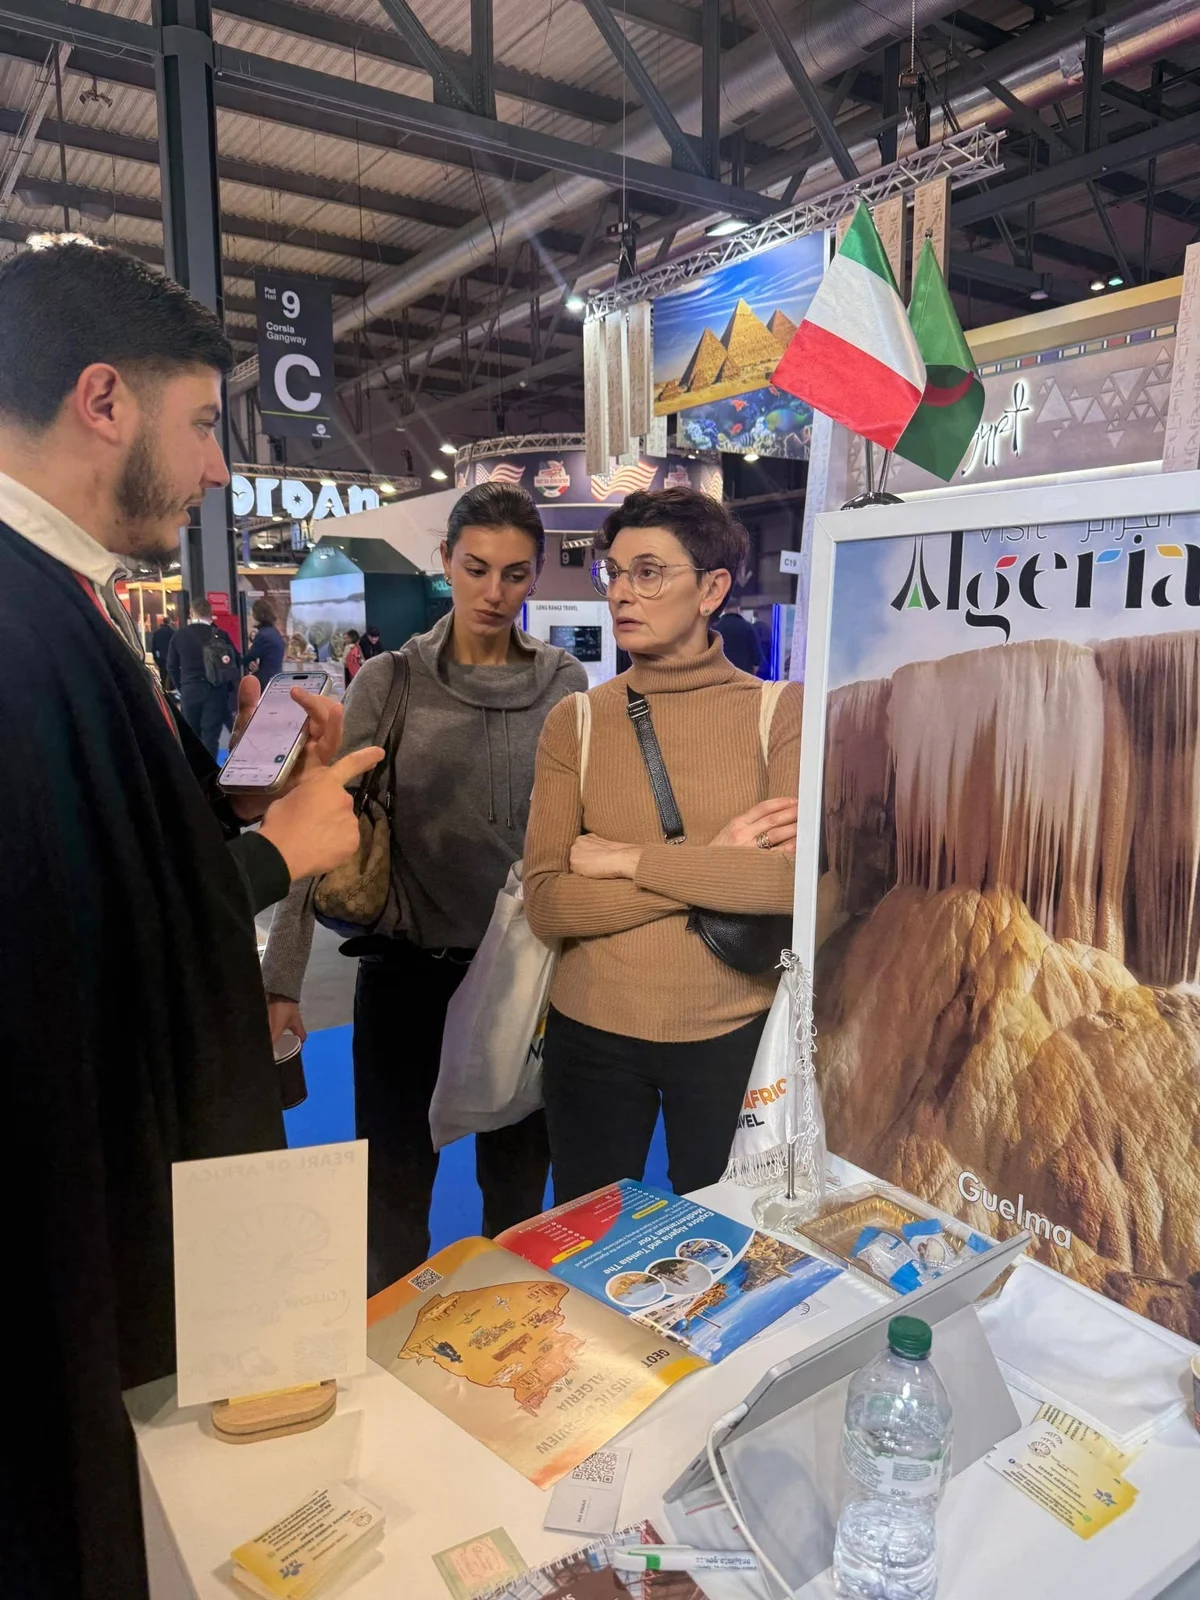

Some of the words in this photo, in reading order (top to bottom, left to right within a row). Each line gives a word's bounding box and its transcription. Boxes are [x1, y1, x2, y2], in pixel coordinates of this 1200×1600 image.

[281, 290, 300, 319] 9
[266, 322, 295, 333] Corsia
[266, 331, 307, 346] Gangway
[274, 353, 322, 412] C
[562, 552, 570, 565] 9
[784, 558, 797, 567] C19
[890, 531, 1200, 643] Algeria
[959, 1171, 1071, 1249] Guelma
[654, 1208, 706, 1237] Mediterranean
[689, 1210, 715, 1228] Explore
[638, 1232, 658, 1246] Tour
[658, 1225, 689, 1242] Algeria
[647, 1239, 660, 1251] and
[619, 1247, 649, 1266] Tunisia
[603, 1261, 622, 1275] The
[557, 1371, 605, 1412] ALGERIA
